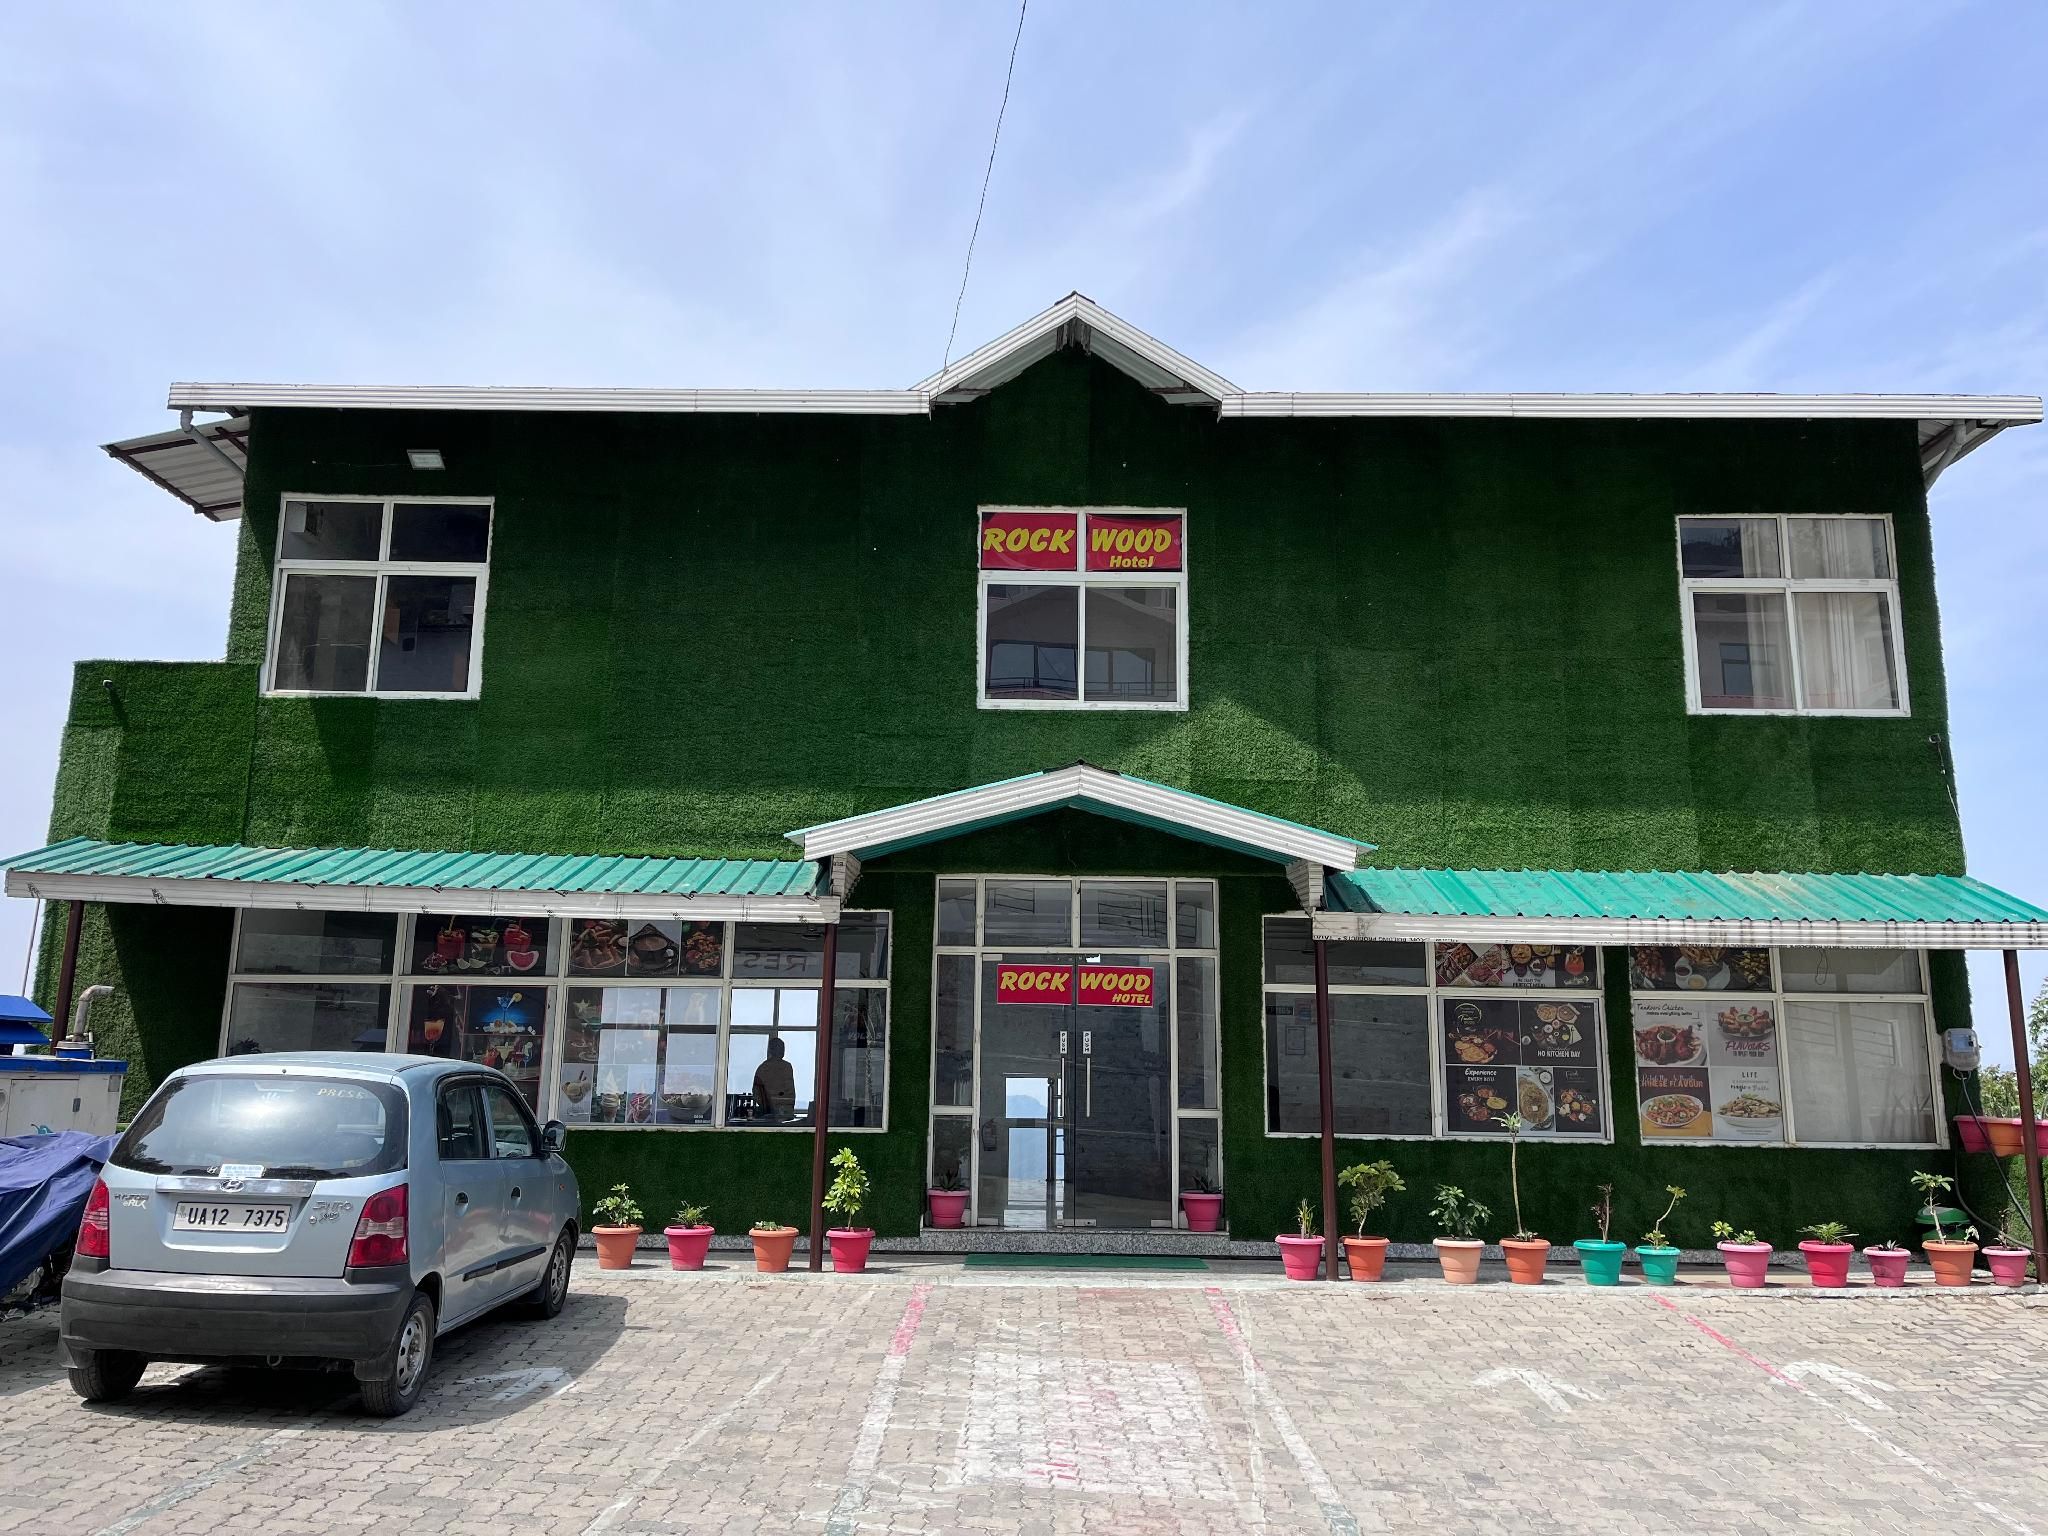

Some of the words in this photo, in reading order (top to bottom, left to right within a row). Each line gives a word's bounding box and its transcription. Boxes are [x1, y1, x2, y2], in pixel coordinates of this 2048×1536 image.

[983, 527, 1075, 554] ROCK
[1091, 527, 1172, 553] WOOD
[1109, 555, 1155, 568] Hotel
[1000, 971, 1070, 992] ROCK
[1080, 973, 1151, 991] WOOD
[1111, 993, 1151, 1004] HOTEL
[1464, 1067, 1497, 1076] Experience
[243, 1209, 285, 1227] 7375
